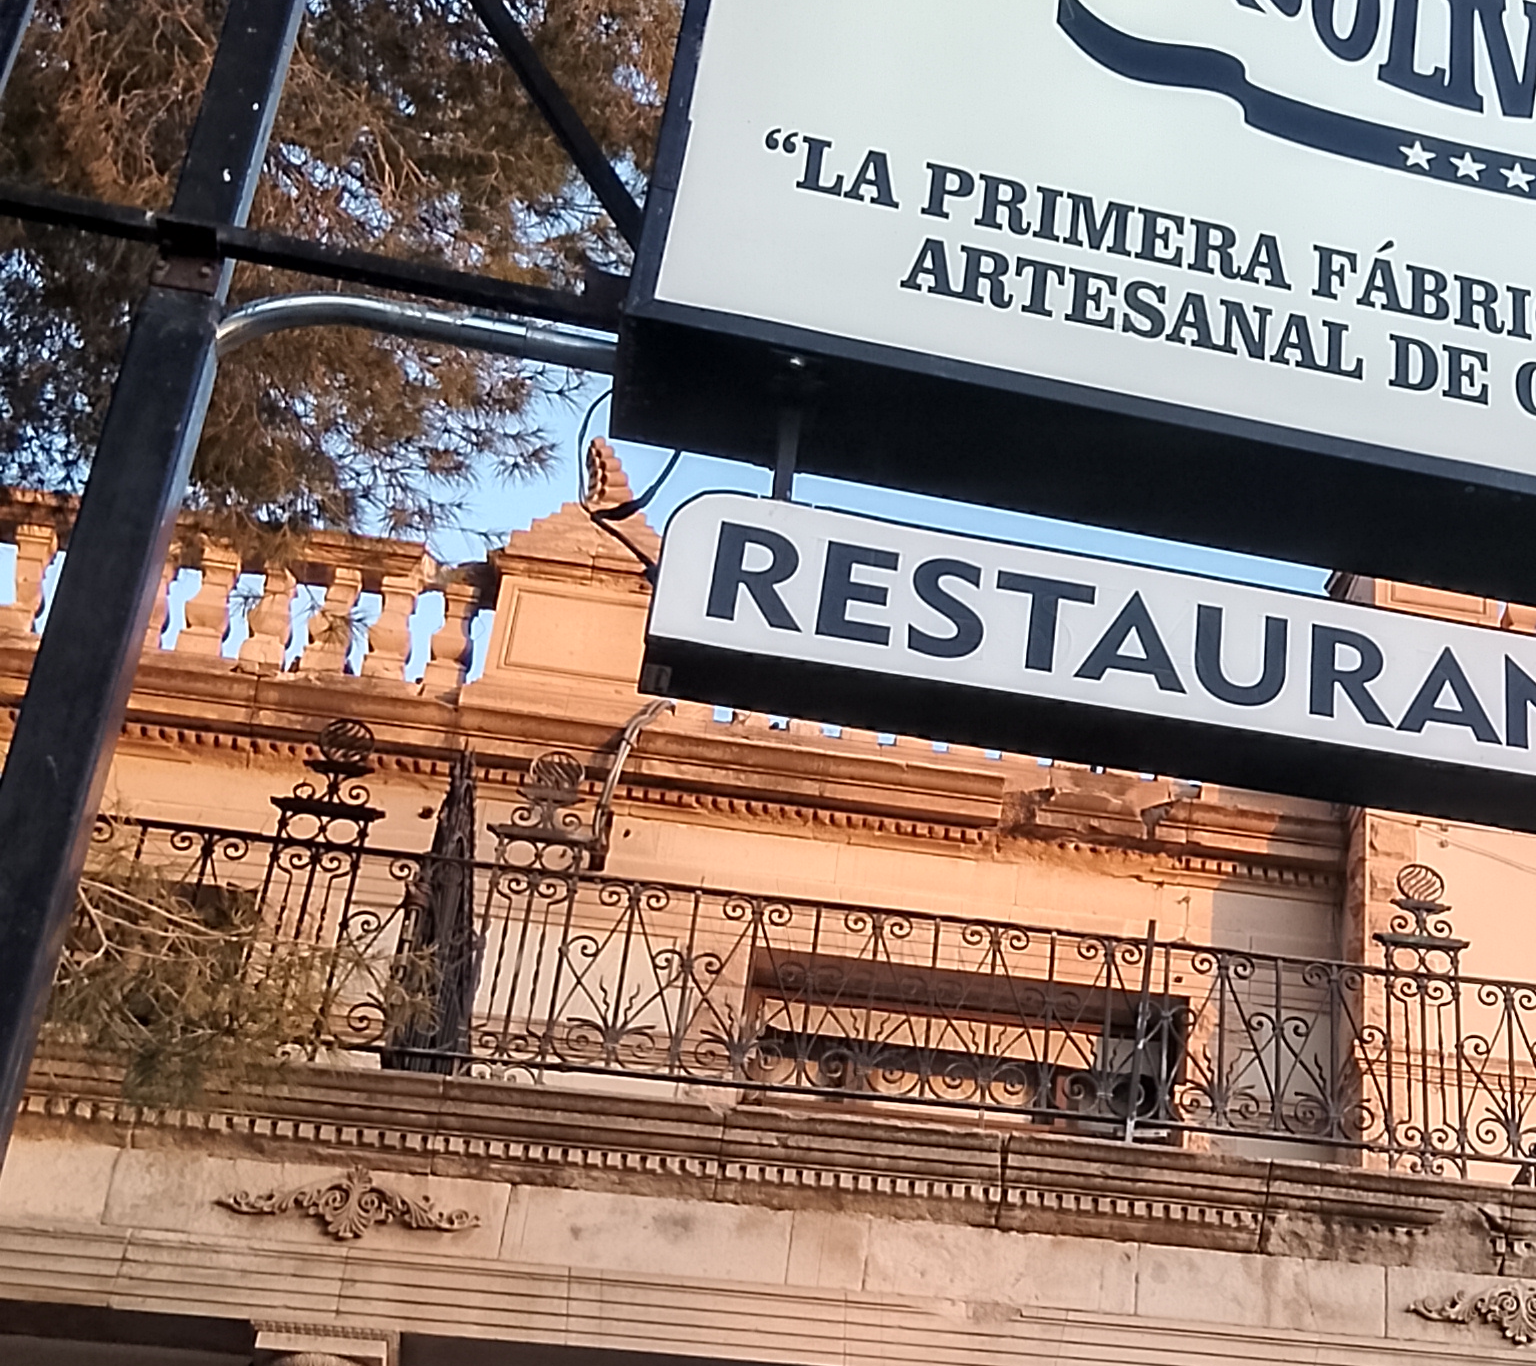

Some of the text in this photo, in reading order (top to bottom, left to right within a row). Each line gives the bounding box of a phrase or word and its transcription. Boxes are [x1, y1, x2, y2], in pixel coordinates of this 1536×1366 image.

[765, 128, 899, 209] “LA
[920, 162, 1291, 290] PRIMERA
[900, 237, 1363, 381] ARTESANAL
[1388, 333, 1490, 405] DE
